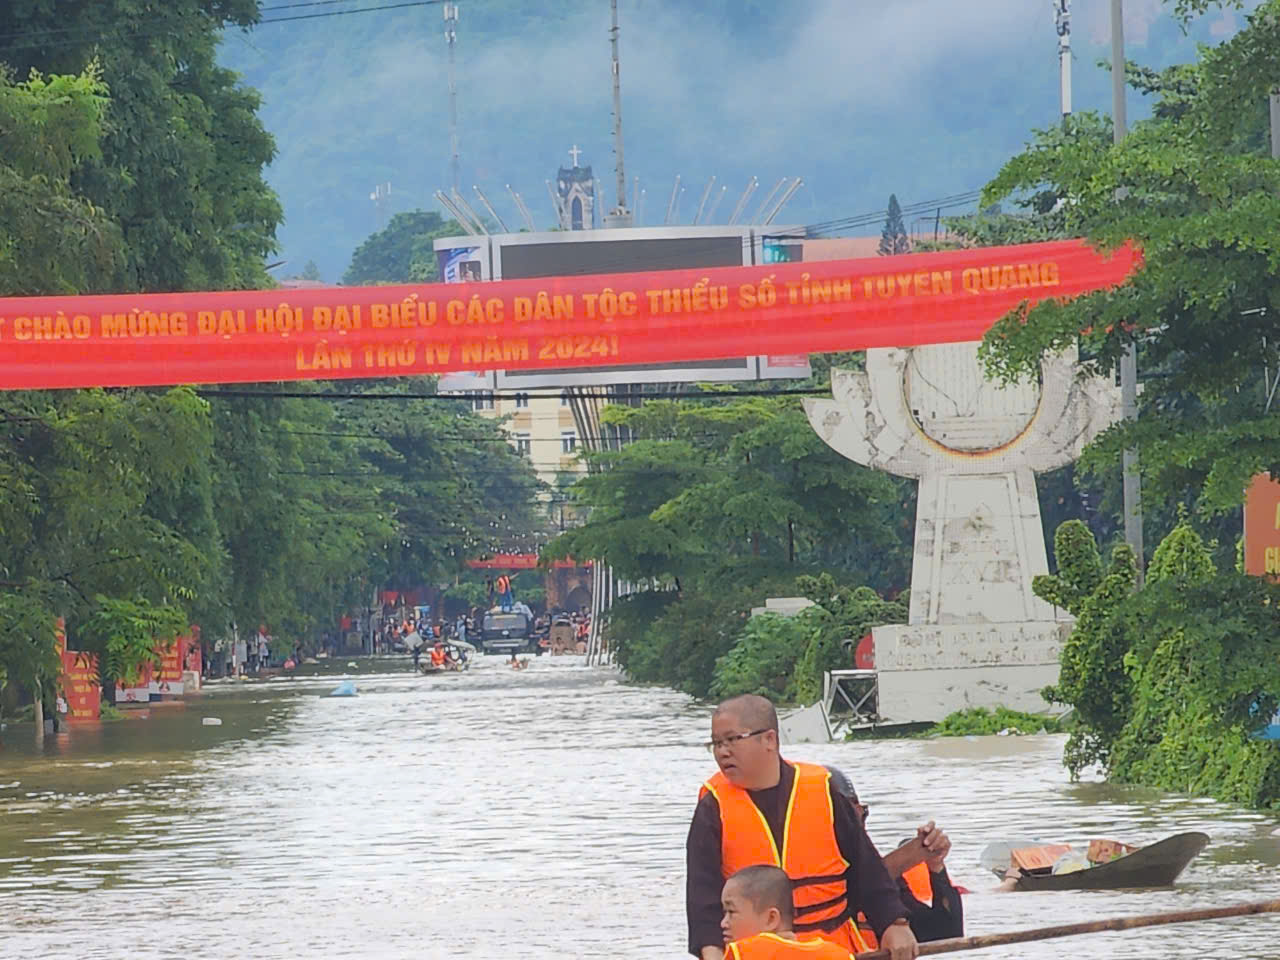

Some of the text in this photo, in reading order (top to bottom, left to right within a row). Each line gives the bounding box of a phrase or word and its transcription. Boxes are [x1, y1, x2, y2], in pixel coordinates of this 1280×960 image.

[14, 310, 91, 341] CHÀO
[101, 307, 188, 338] MỪNG
[197, 308, 246, 340] ĐẠI
[255, 302, 304, 338] HỘI
[313, 303, 362, 336] ĐẠI
[371, 292, 437, 329] BIỂU
[446, 293, 504, 326] CÁC
[514, 290, 573, 322] DÂN
[583, 287, 638, 323] TỘC
[646, 277, 728, 314] THIỂU
[738, 273, 777, 309] SỐ
[785, 272, 852, 305] TỈNH
[962, 261, 1060, 295] QUANG
[296, 334, 618, 371] LẦN THỨ IV NĂM 2024!
